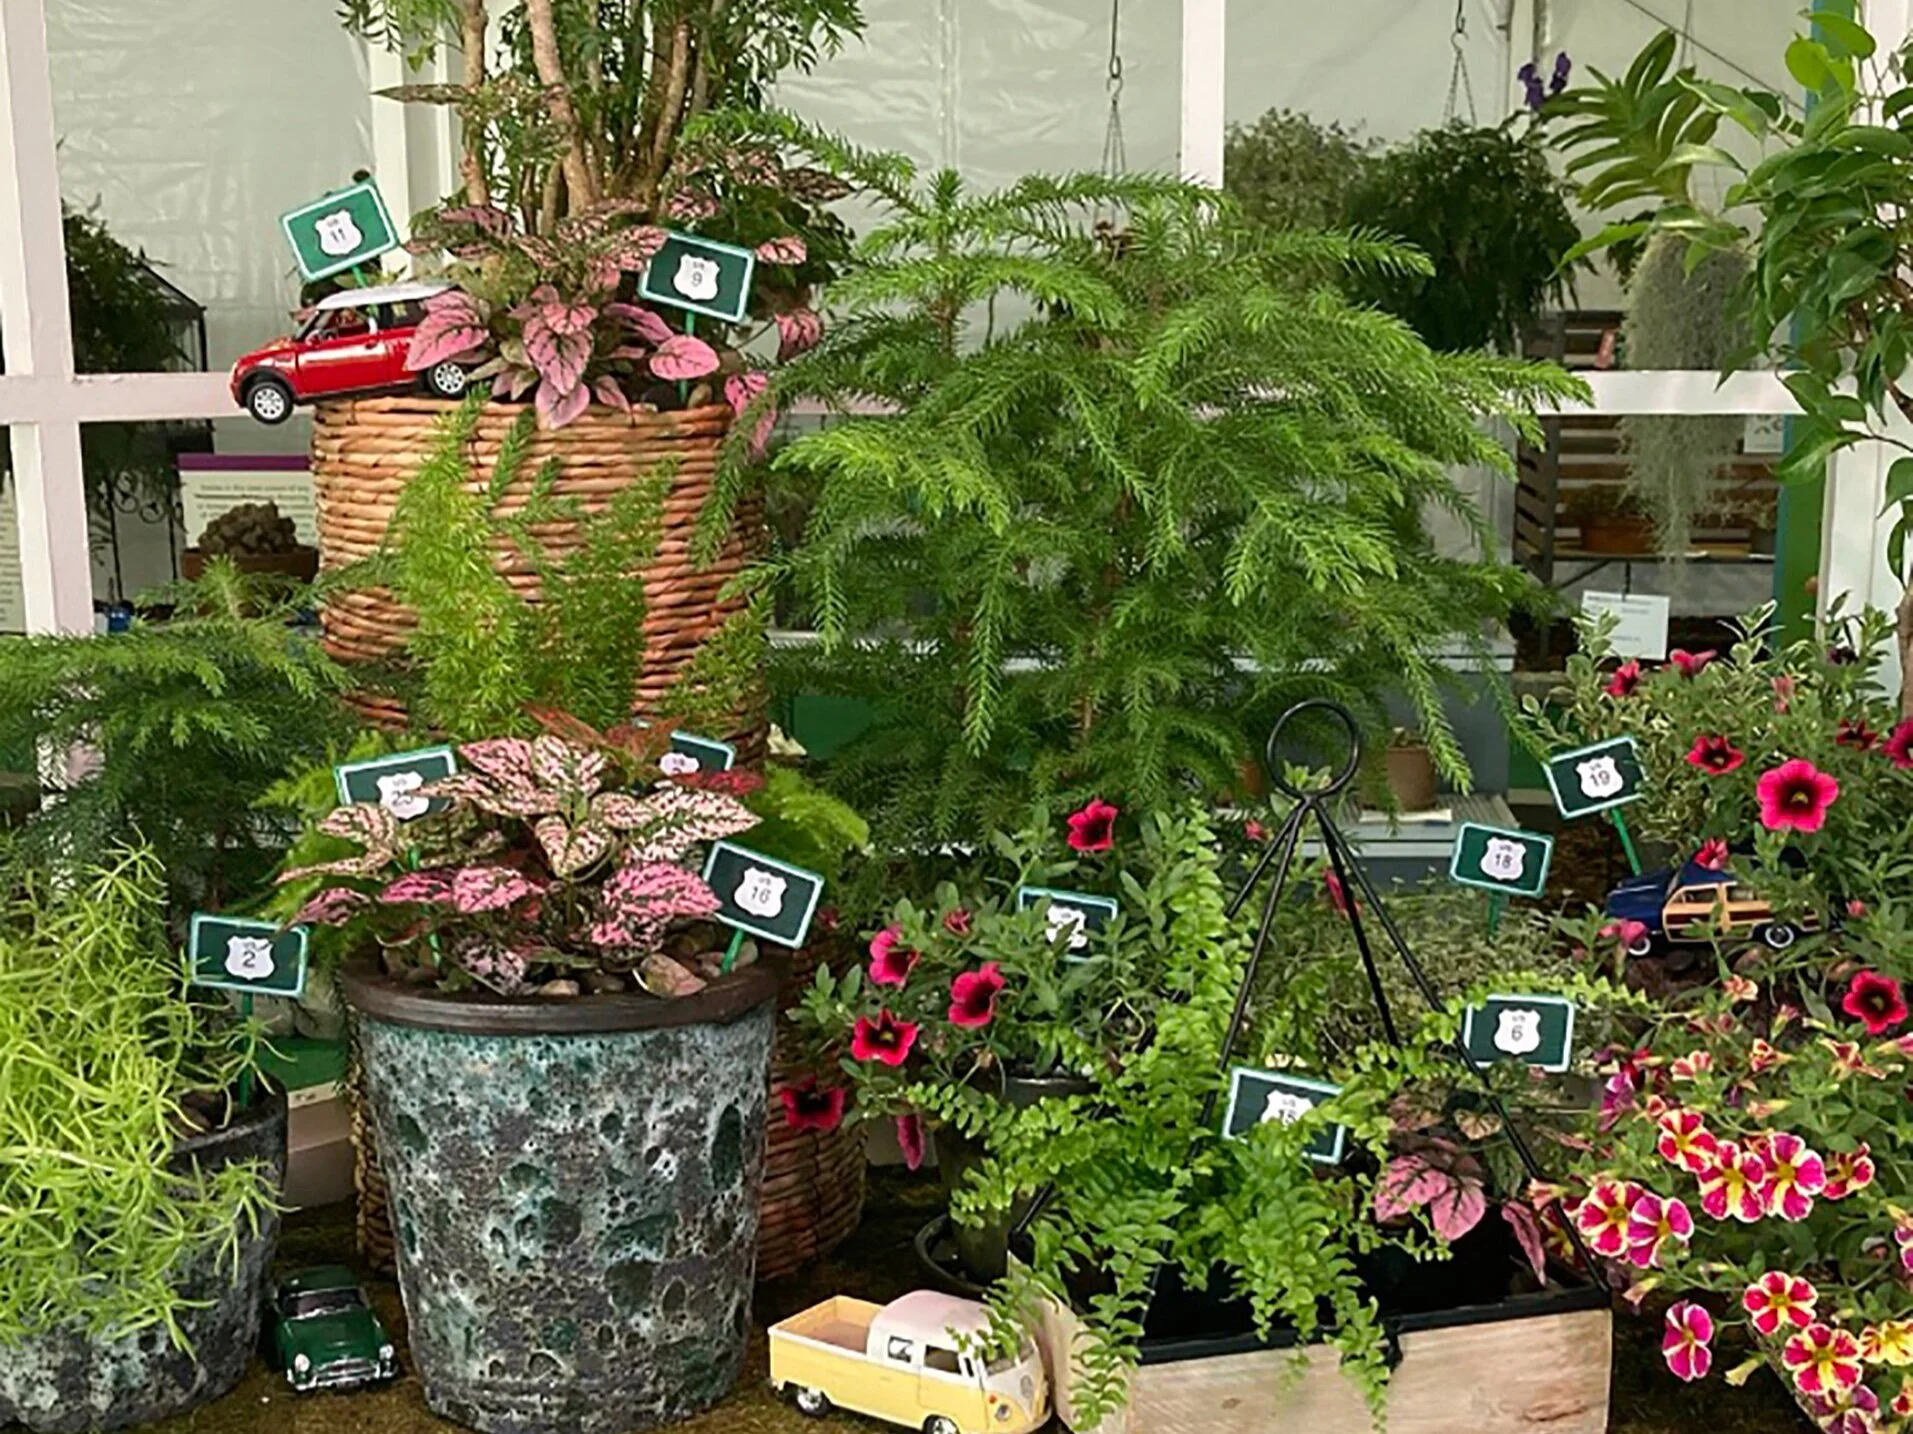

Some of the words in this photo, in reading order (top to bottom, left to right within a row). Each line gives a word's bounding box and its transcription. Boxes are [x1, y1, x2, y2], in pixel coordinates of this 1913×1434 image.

[330, 228, 346, 243] 11
[691, 271, 703, 287] 9
[1590, 770, 1610, 787] 19
[1495, 853, 1512, 869] 18
[752, 886, 771, 904] 16
[242, 950, 256, 968] 2
[1511, 1025, 1525, 1041] 6
